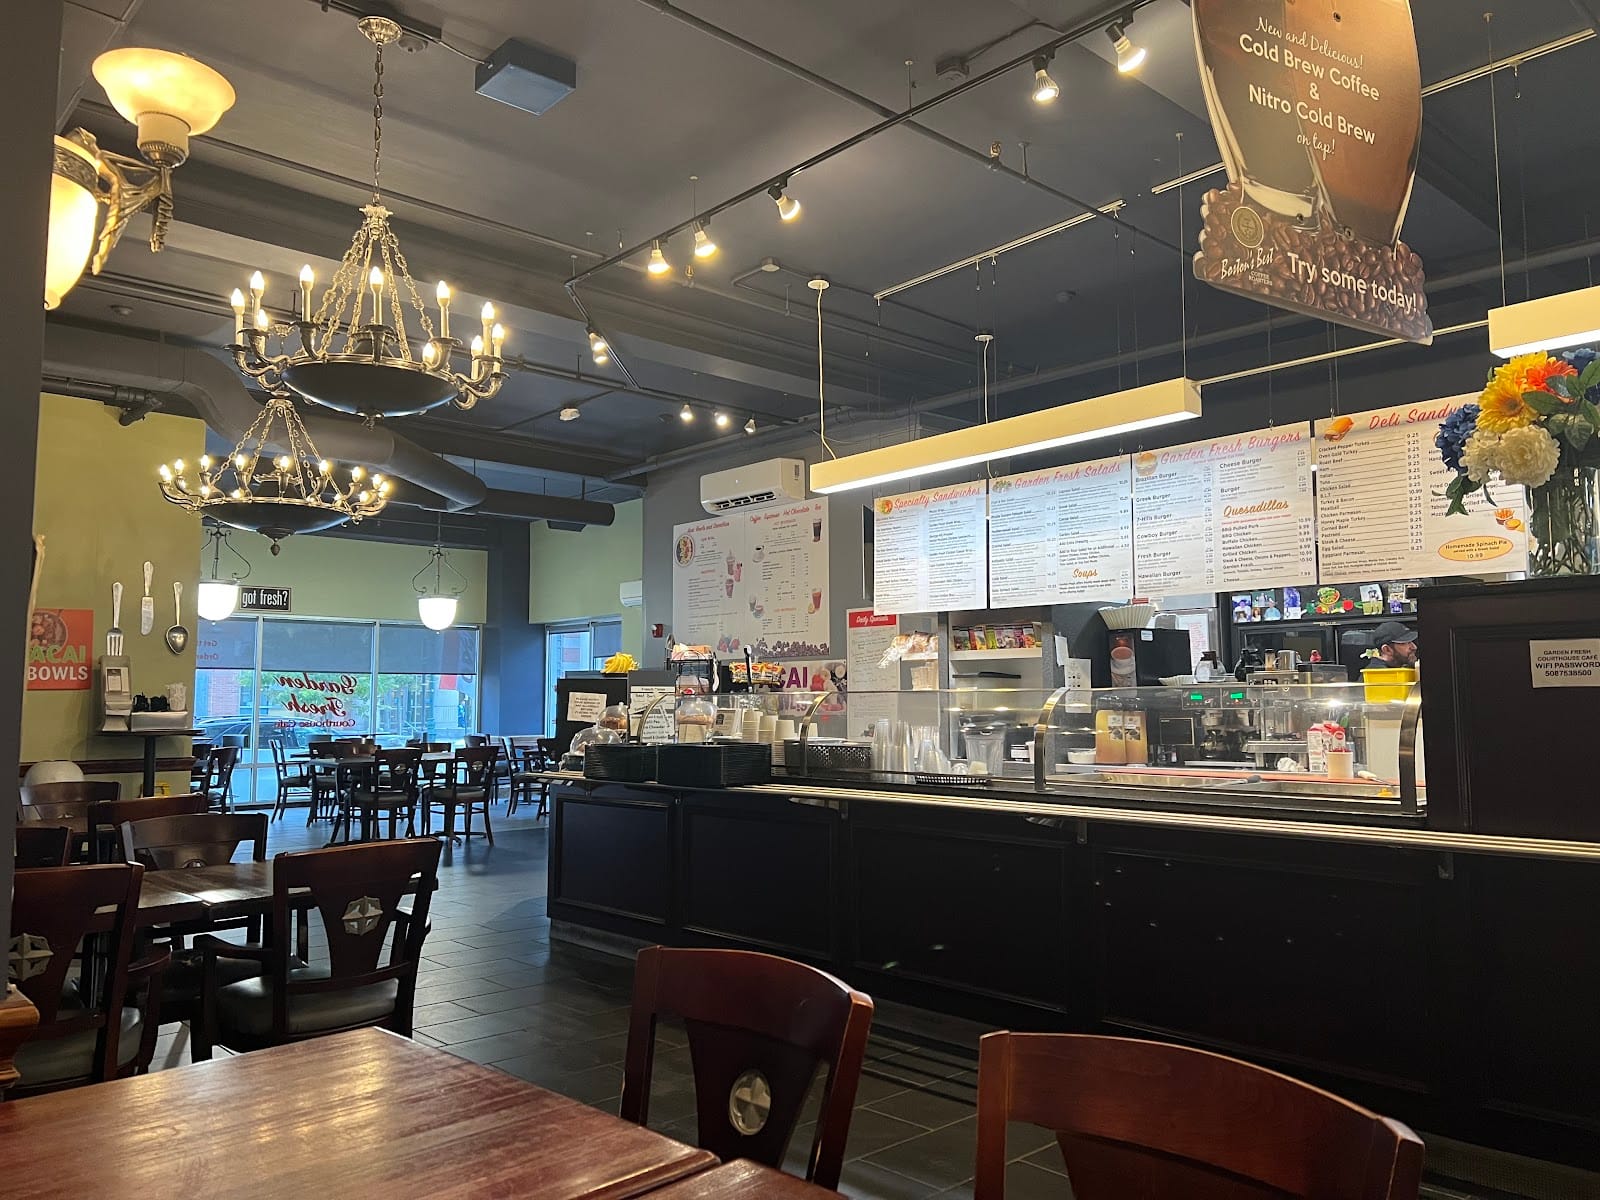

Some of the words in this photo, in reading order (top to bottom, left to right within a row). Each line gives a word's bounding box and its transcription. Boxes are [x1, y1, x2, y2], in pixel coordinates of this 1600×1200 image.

[1256, 16, 1282, 38] New
[1286, 31, 1308, 47] and
[1310, 35, 1364, 69] Delicious!
[1240, 34, 1279, 63] Cold
[1284, 49, 1324, 79] Brew
[1330, 67, 1380, 101] Coffee
[1310, 83, 1319, 100] &
[1249, 84, 1291, 114] Nitro
[1296, 102, 1333, 129] Cold
[1338, 116, 1375, 145] Brew
[1297, 134, 1310, 145] on
[1313, 132, 1335, 160] tap!
[1221, 250, 1254, 279] Boston's
[1256, 247, 1273, 268] Best
[1288, 253, 1317, 283] Try
[1322, 267, 1367, 294] some
[1371, 281, 1416, 314] today!
[1370, 412, 1400, 430] Deli
[1160, 449, 1204, 465] Garden
[1209, 439, 1243, 456] Fresh
[1248, 431, 1301, 452] Burgers
[1015, 478, 1050, 489] Garden
[1053, 468, 1080, 482] Fresh
[1085, 461, 1121, 476] Salads
[894, 493, 929, 510] Specialty
[933, 487, 980, 503] Sandwiches
[1223, 499, 1289, 518] Quesadillas
[1073, 568, 1098, 579] Soups
[243, 590, 256, 607] got
[260, 590, 288, 606] fresh?
[28, 666, 88, 680] BOWLS
